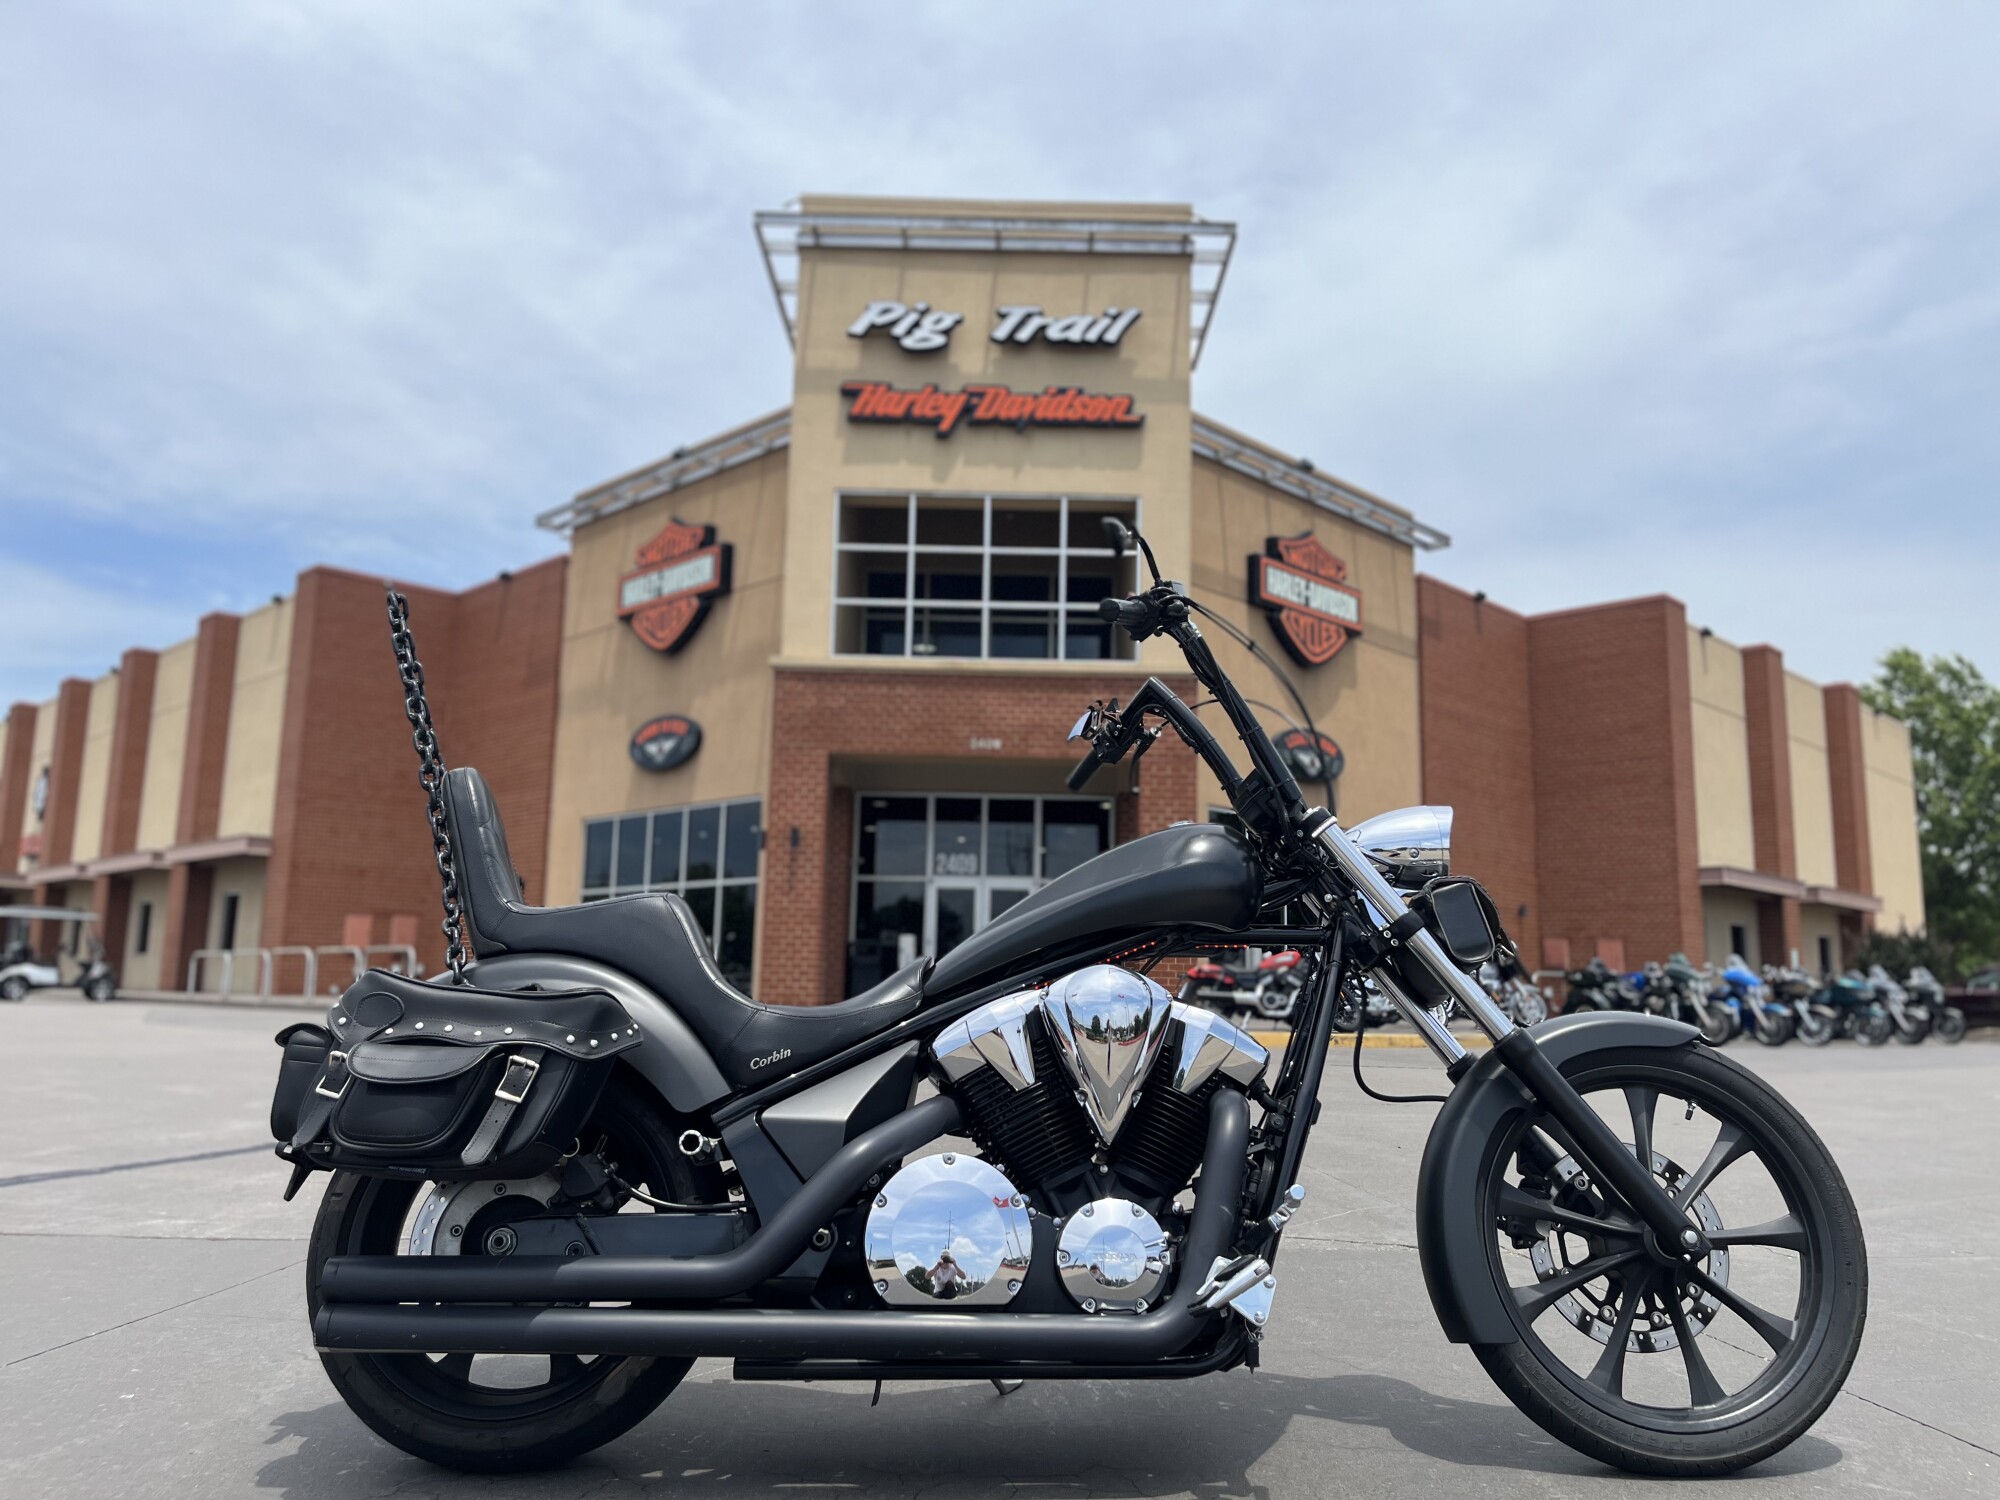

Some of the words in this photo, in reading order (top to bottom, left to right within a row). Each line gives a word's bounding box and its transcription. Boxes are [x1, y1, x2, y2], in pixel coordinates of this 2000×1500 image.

[848, 301, 963, 350] Pig
[990, 305, 1141, 344] Trail
[842, 382, 1144, 435] Harley-Davidson
[1266, 565, 1359, 624] HARLEY-DAVIDSON
[936, 852, 978, 875] 2409
[750, 1048, 791, 1070] Corbin
